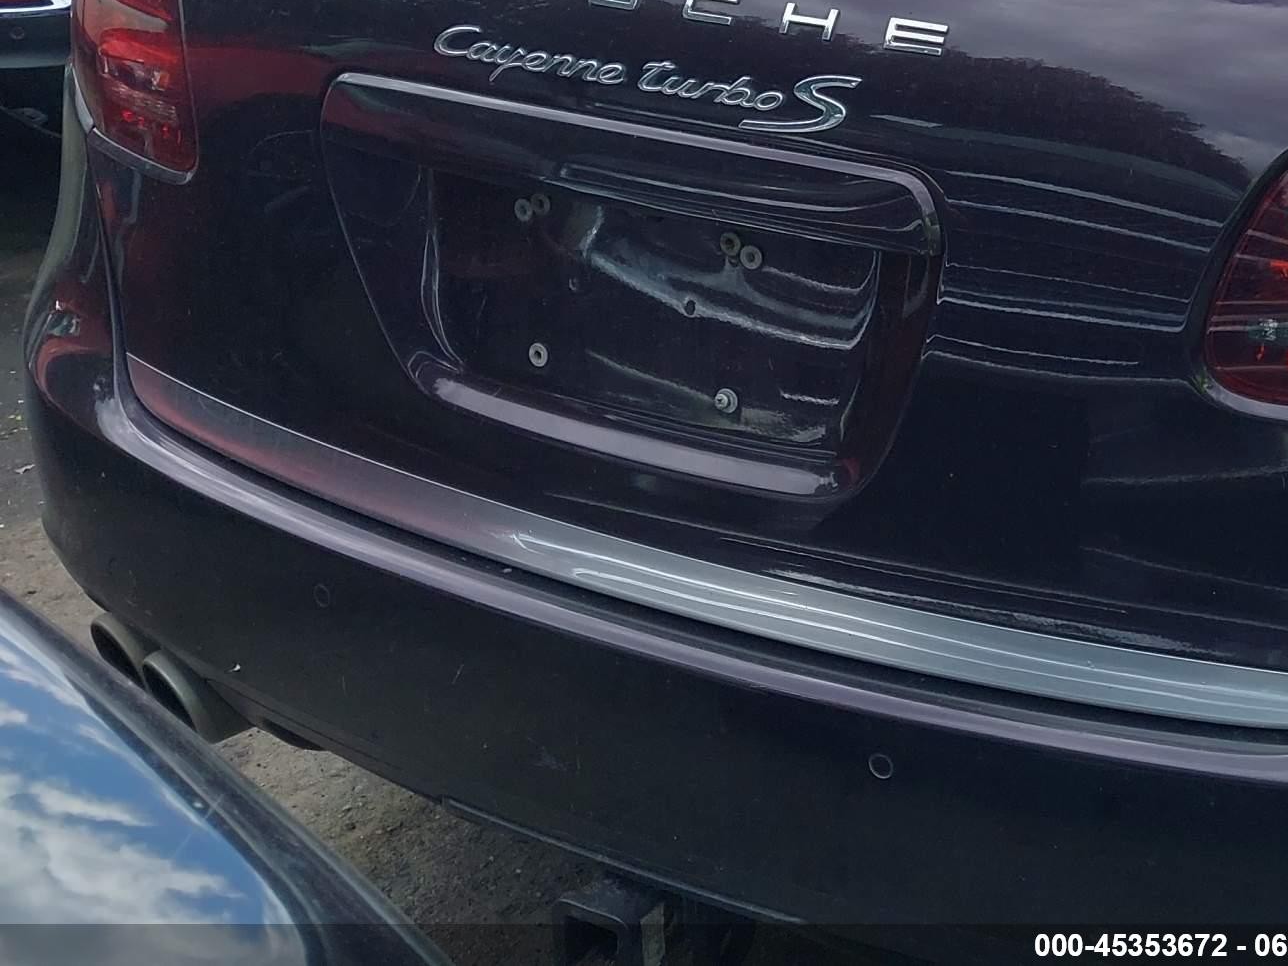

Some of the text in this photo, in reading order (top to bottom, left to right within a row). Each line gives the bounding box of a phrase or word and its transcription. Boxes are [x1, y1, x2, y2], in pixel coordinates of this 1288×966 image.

[433, 25, 863, 133] Cayenne turbo S
